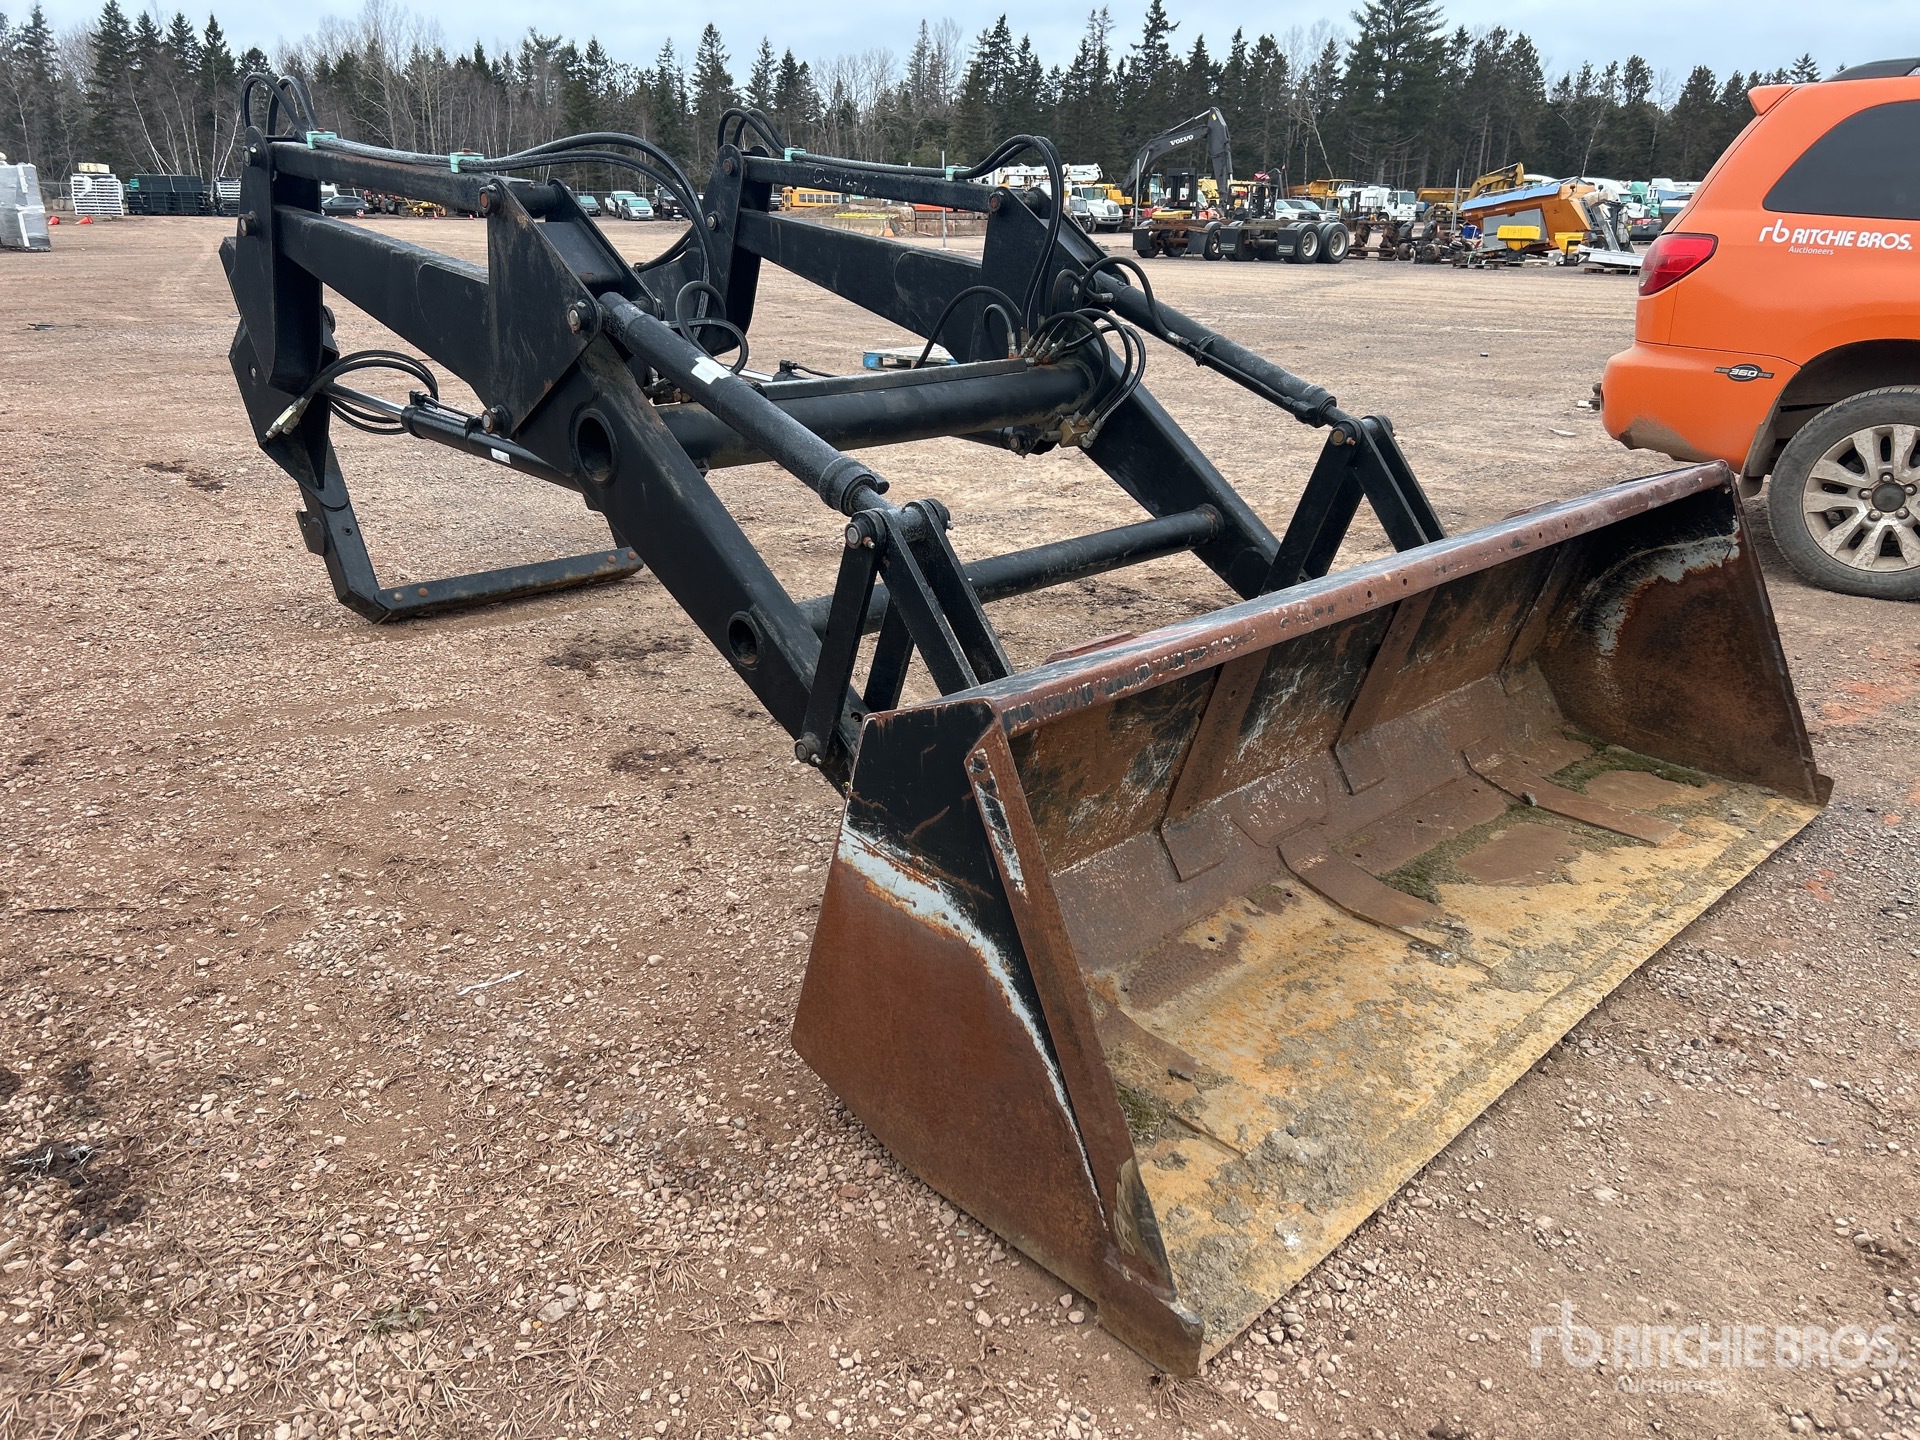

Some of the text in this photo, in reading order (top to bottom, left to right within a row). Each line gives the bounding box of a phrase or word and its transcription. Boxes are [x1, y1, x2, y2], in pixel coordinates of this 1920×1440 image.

[1170, 134, 1194, 146] VOLVO
[1758, 218, 1913, 251] rb RITCHIE BROS.
[1788, 245, 1834, 255] Auctioneers
[1729, 368, 1758, 377] 360
